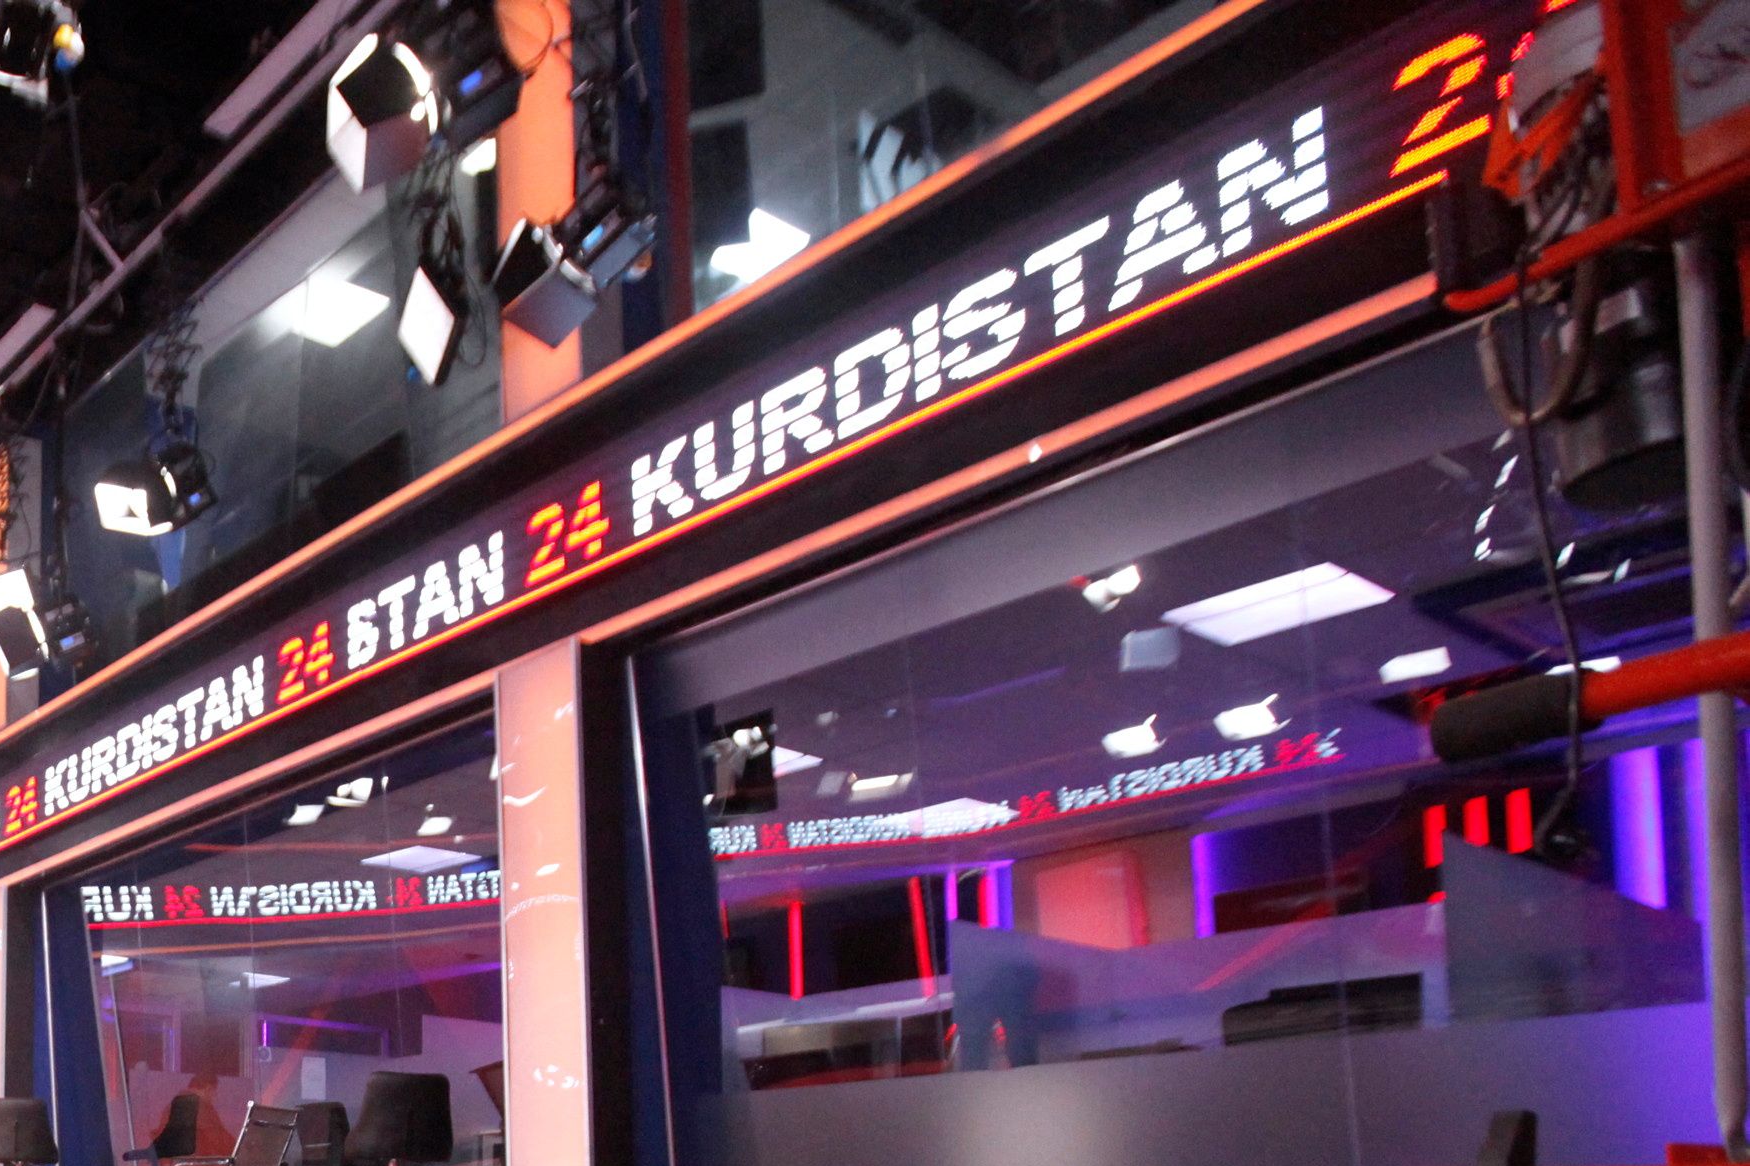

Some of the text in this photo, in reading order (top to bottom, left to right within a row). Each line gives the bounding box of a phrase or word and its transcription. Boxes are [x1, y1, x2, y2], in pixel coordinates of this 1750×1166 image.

[3, 776, 39, 834] 24
[44, 655, 265, 817] KURDISTAN
[276, 621, 335, 702] 24
[525, 480, 612, 588] 24
[631, 106, 1329, 537] KURDISTAN
